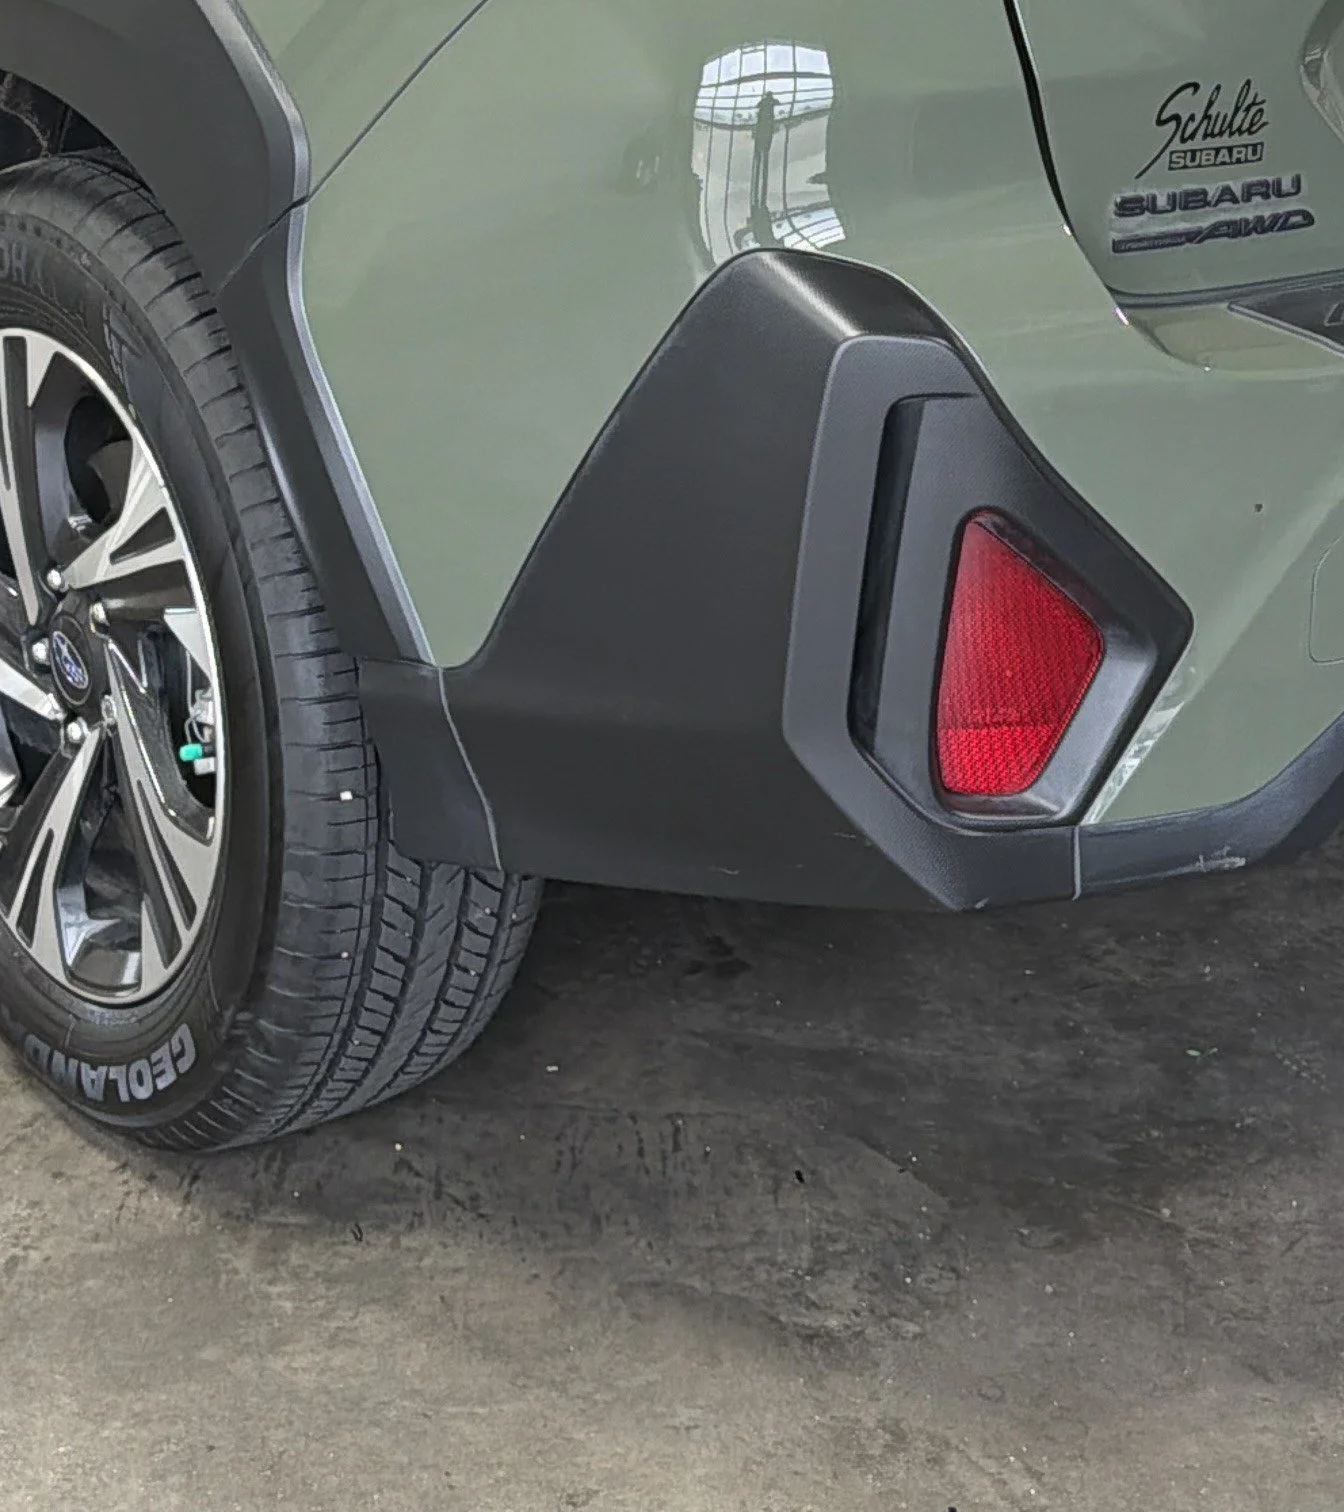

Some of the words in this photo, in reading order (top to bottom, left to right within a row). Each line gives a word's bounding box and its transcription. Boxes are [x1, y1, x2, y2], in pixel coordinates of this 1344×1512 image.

[1134, 78, 1270, 179] Schulte
[1169, 144, 1264, 170] SUBARU
[1113, 174, 1302, 218] SUBARU
[1194, 208, 1316, 244] AWD
